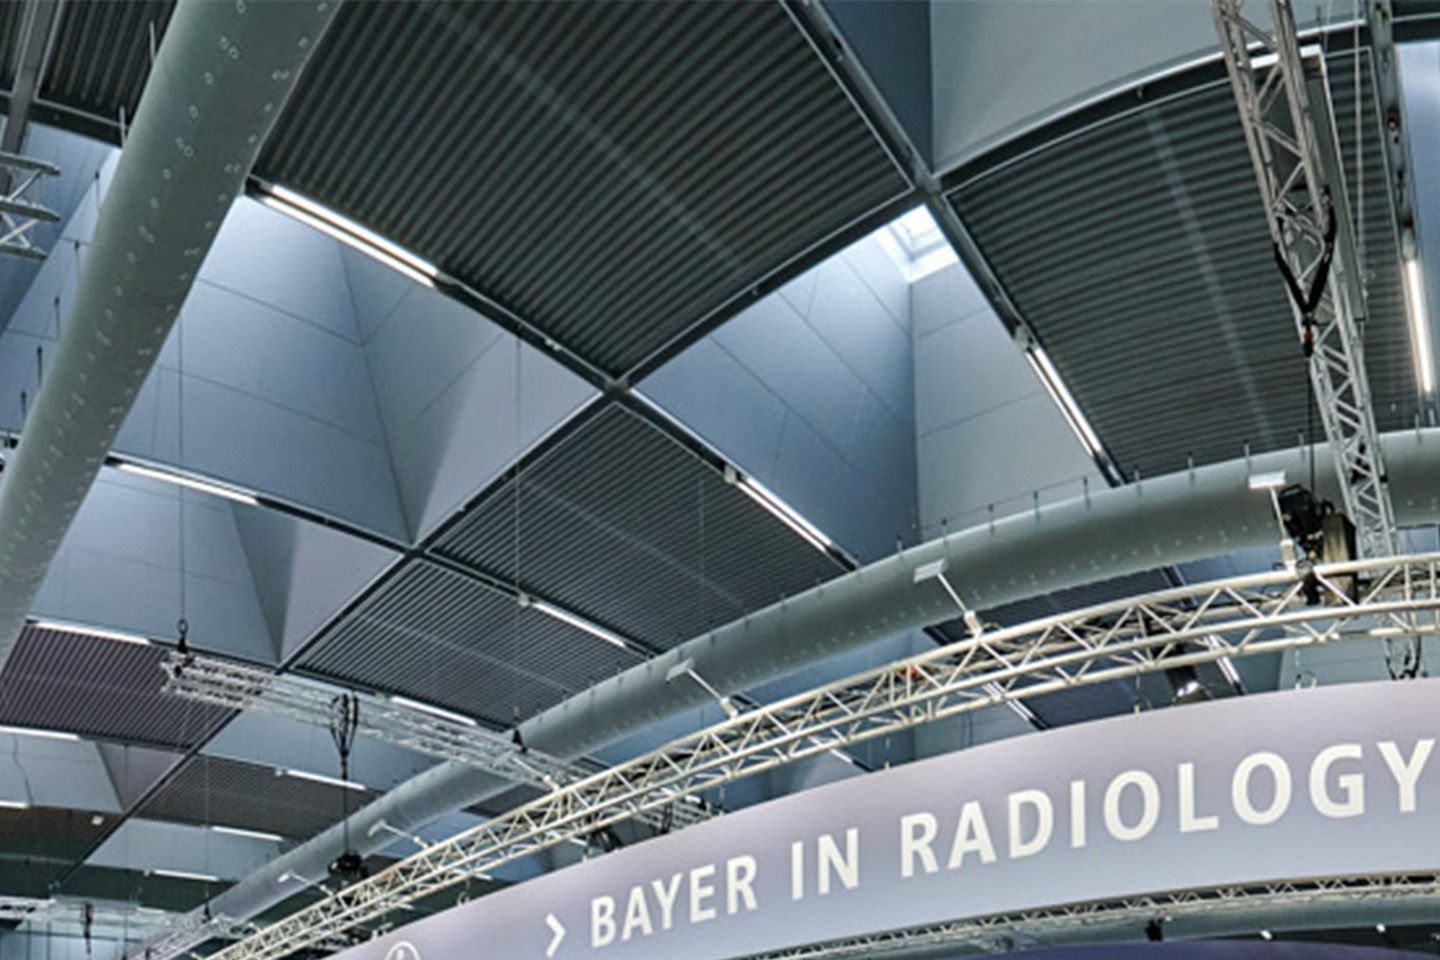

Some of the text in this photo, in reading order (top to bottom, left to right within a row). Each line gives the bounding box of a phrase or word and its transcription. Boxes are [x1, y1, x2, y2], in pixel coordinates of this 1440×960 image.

[589, 737, 1437, 949] BAYER IN RADIOLOGY
